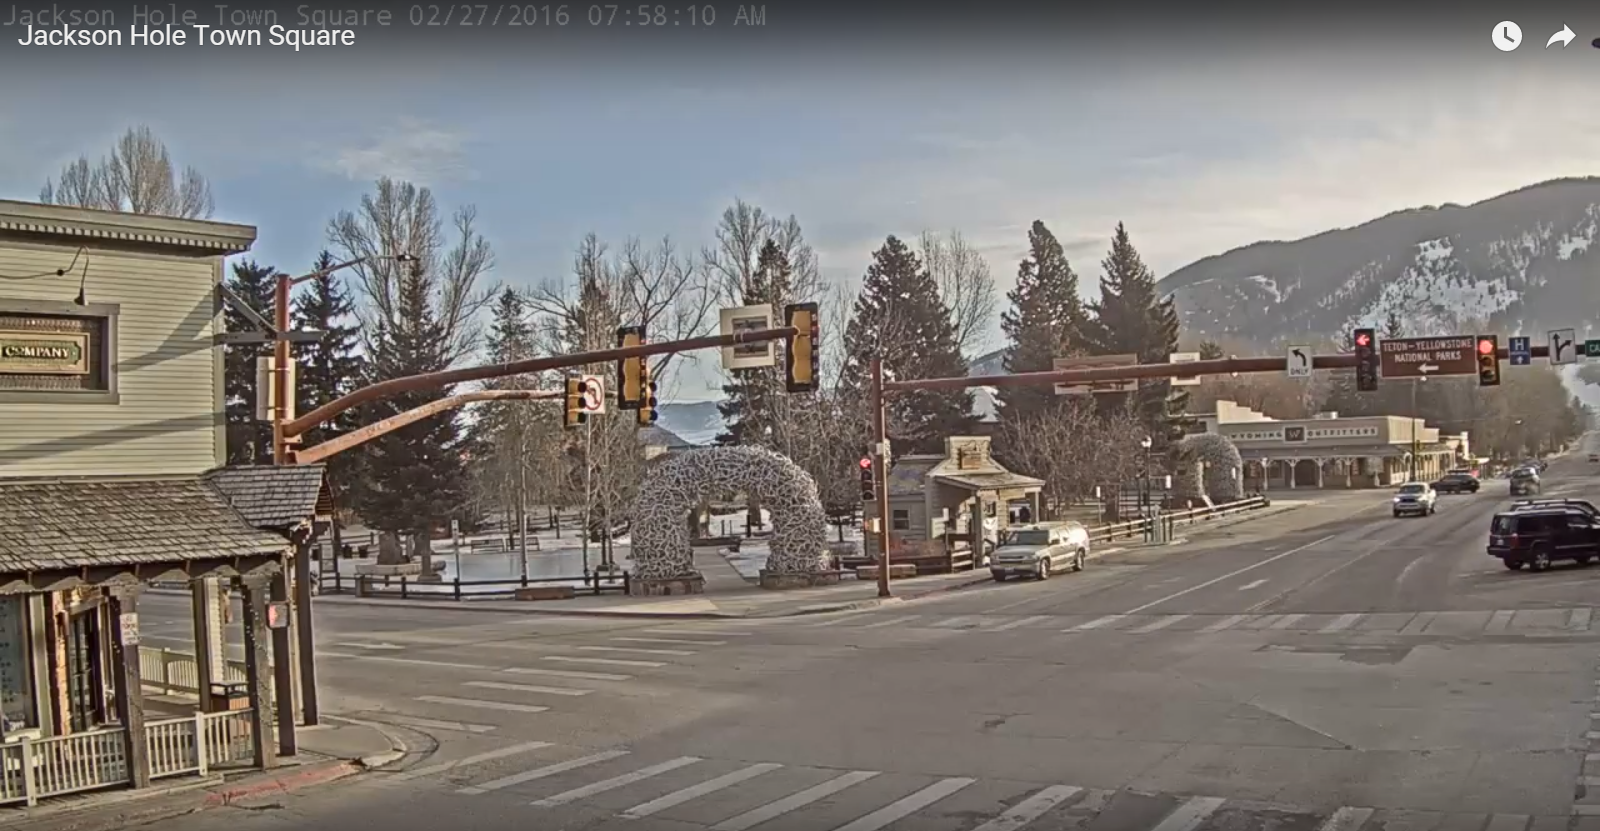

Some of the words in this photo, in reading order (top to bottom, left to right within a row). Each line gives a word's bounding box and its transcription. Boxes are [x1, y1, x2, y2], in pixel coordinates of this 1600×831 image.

[1514, 339, 1525, 351] H
[5, 346, 69, 358] COMPANY
[1394, 351, 1431, 363] NATIONAL
[1435, 350, 1462, 360] PARKS
[1231, 431, 1282, 440] WYOMING
[1307, 427, 1376, 438] OUTFITTERS
